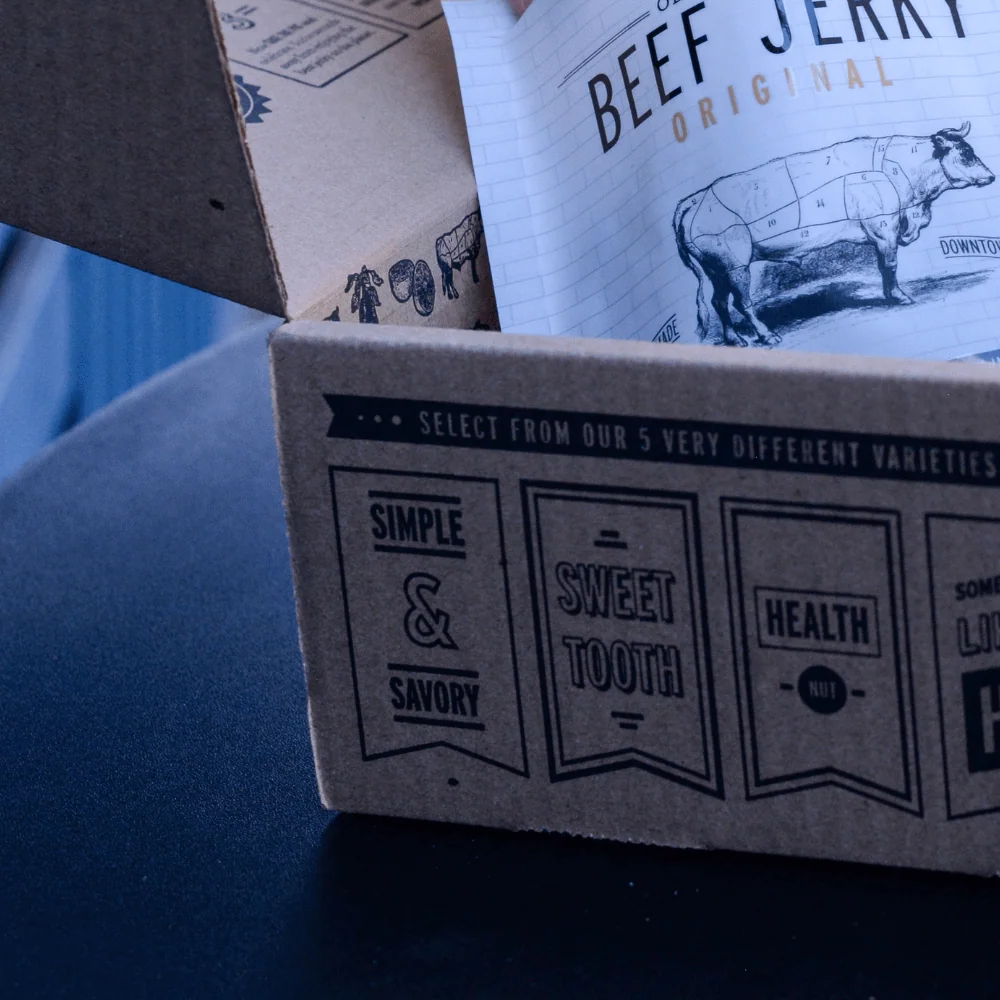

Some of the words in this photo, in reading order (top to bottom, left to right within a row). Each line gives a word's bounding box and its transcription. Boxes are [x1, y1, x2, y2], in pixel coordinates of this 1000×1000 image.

[587, 1, 709, 154] BEEF
[671, 56, 894, 143] ORIGINAL
[419, 409, 498, 440] SELECT
[510, 416, 571, 446] FROM
[583, 422, 628, 450] OUR
[639, 426, 652, 452] 5
[663, 429, 720, 457] VERY
[733, 435, 860, 468] DIFFERENT
[871, 443, 998, 479] VARIETIES
[369, 503, 467, 547] SIMPLE
[402, 571, 460, 651] &
[556, 561, 676, 625] SWEET
[765, 598, 870, 645] HEALTH
[389, 676, 480, 717] SAVORY
[562, 635, 685, 699] TOOTH
[808, 680, 837, 699] NUT
